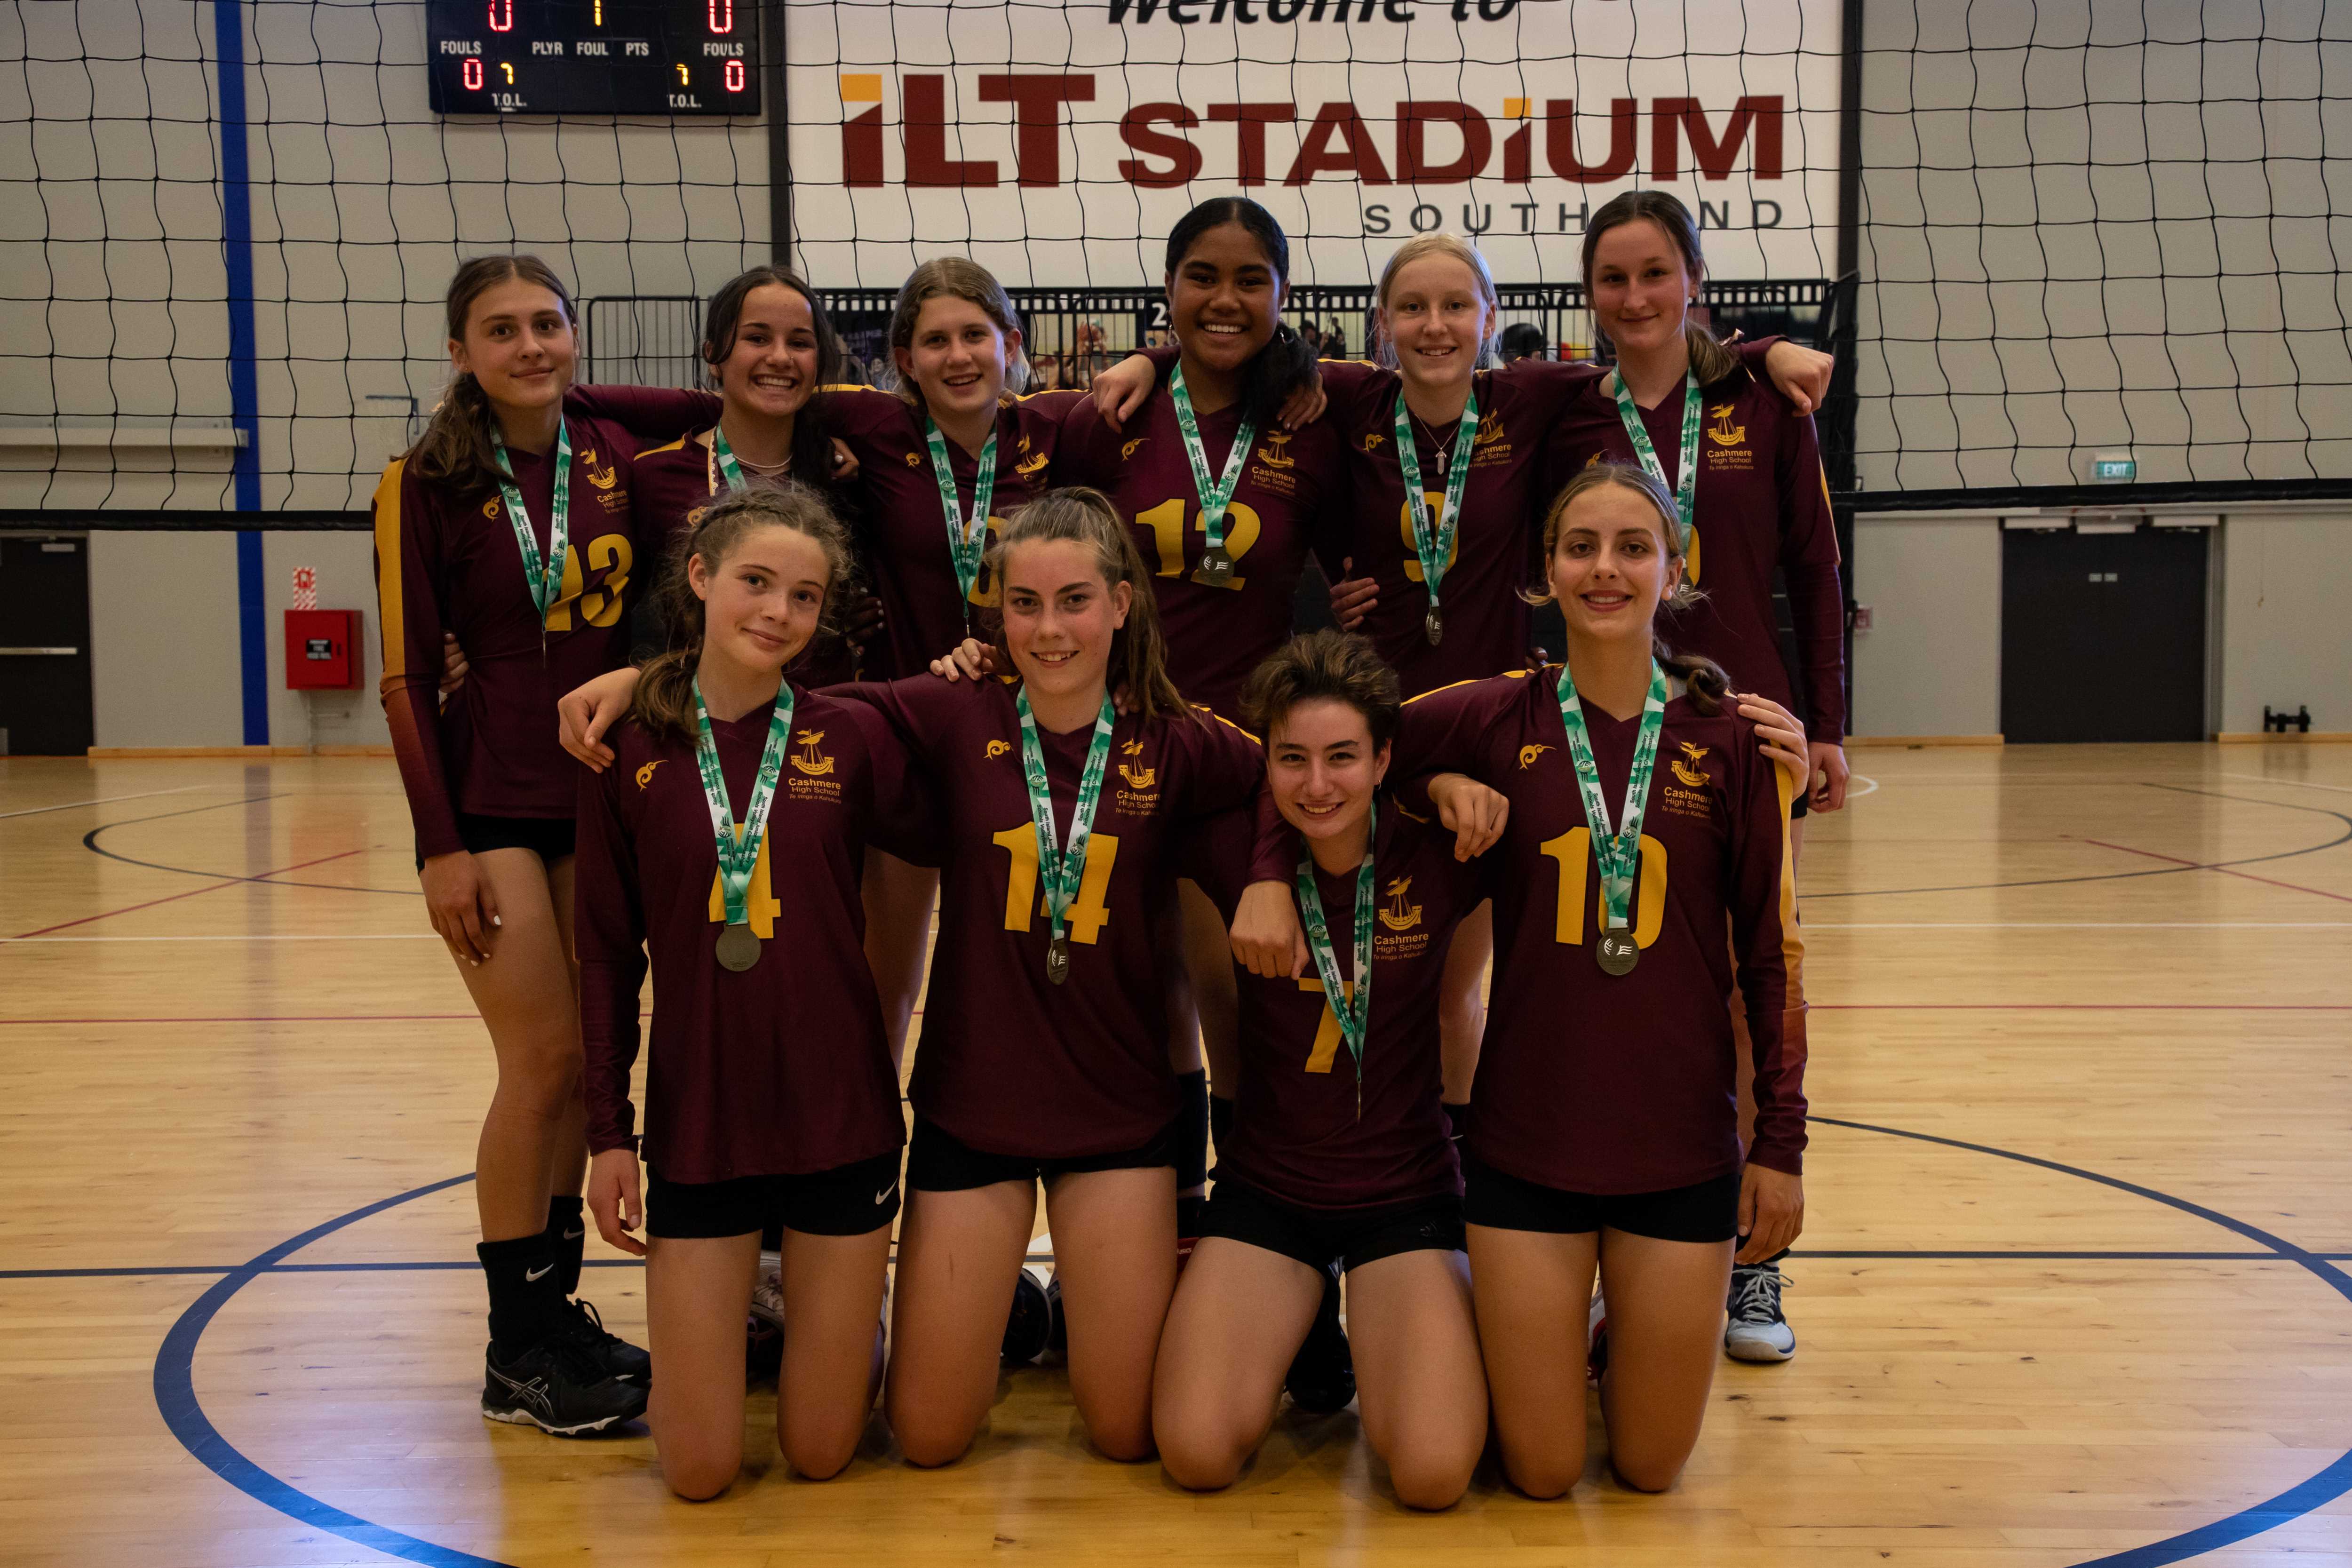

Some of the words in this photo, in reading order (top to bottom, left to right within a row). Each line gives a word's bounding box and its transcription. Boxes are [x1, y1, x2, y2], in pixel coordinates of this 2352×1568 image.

[441, 40, 482, 55] FOULS
[532, 41, 563, 56] PLYR
[576, 42, 609, 56] FOUL
[626, 42, 649, 56] PTS
[703, 42, 744, 56] FOULS
[463, 58, 483, 90] 0
[501, 62, 514, 85] 7
[675, 63, 689, 87] 7
[725, 60, 745, 92] 0
[492, 93, 527, 107] T.O.L.
[667, 94, 702, 108] T.O.L.
[1364, 200, 1782, 232] SOUTHND
[1476, 444, 1512, 456] ashmere
[1707, 449, 1752, 458] Cashmere
[1252, 466, 1295, 484] Cashmere
[1254, 474, 1270, 483] High
[1272, 478, 1295, 489] School
[2104, 464, 2127, 477] EXIT
[1136, 498, 1261, 591] 12
[1400, 492, 1458, 582] 9
[542, 533, 632, 631] 13
[1639, 733, 1648, 758] Secondary
[1088, 754, 1097, 778] Secondary
[1639, 766, 1648, 788] Volleyball
[1644, 731, 1654, 765] Championships
[711, 769, 720, 789] Volleyball
[788, 778, 841, 789] Cashmere
[1087, 785, 1096, 807] Volleyball
[1092, 752, 1104, 785] Championships
[814, 787, 839, 796] School
[1664, 787, 1713, 804] Cashmere
[1119, 799, 1135, 808] High
[1666, 797, 1685, 807] High
[1687, 800, 1710, 812] School
[748, 808, 758, 830] Volleyball
[1586, 790, 1594, 809] Schools
[1590, 810, 1600, 832] Volleyball
[1596, 833, 1610, 870] Championships
[738, 830, 752, 867] Championships
[1043, 847, 1052, 883] Championships
[709, 822, 781, 939] 4
[993, 821, 1119, 945] 14
[1540, 826, 1668, 949] 10
[1374, 933, 1429, 945] Cashmere
[1399, 941, 1427, 952] School
[1320, 955, 1328, 973] Schools
[1325, 974, 1336, 995] Volleyball
[1298, 978, 1354, 1073] 7
